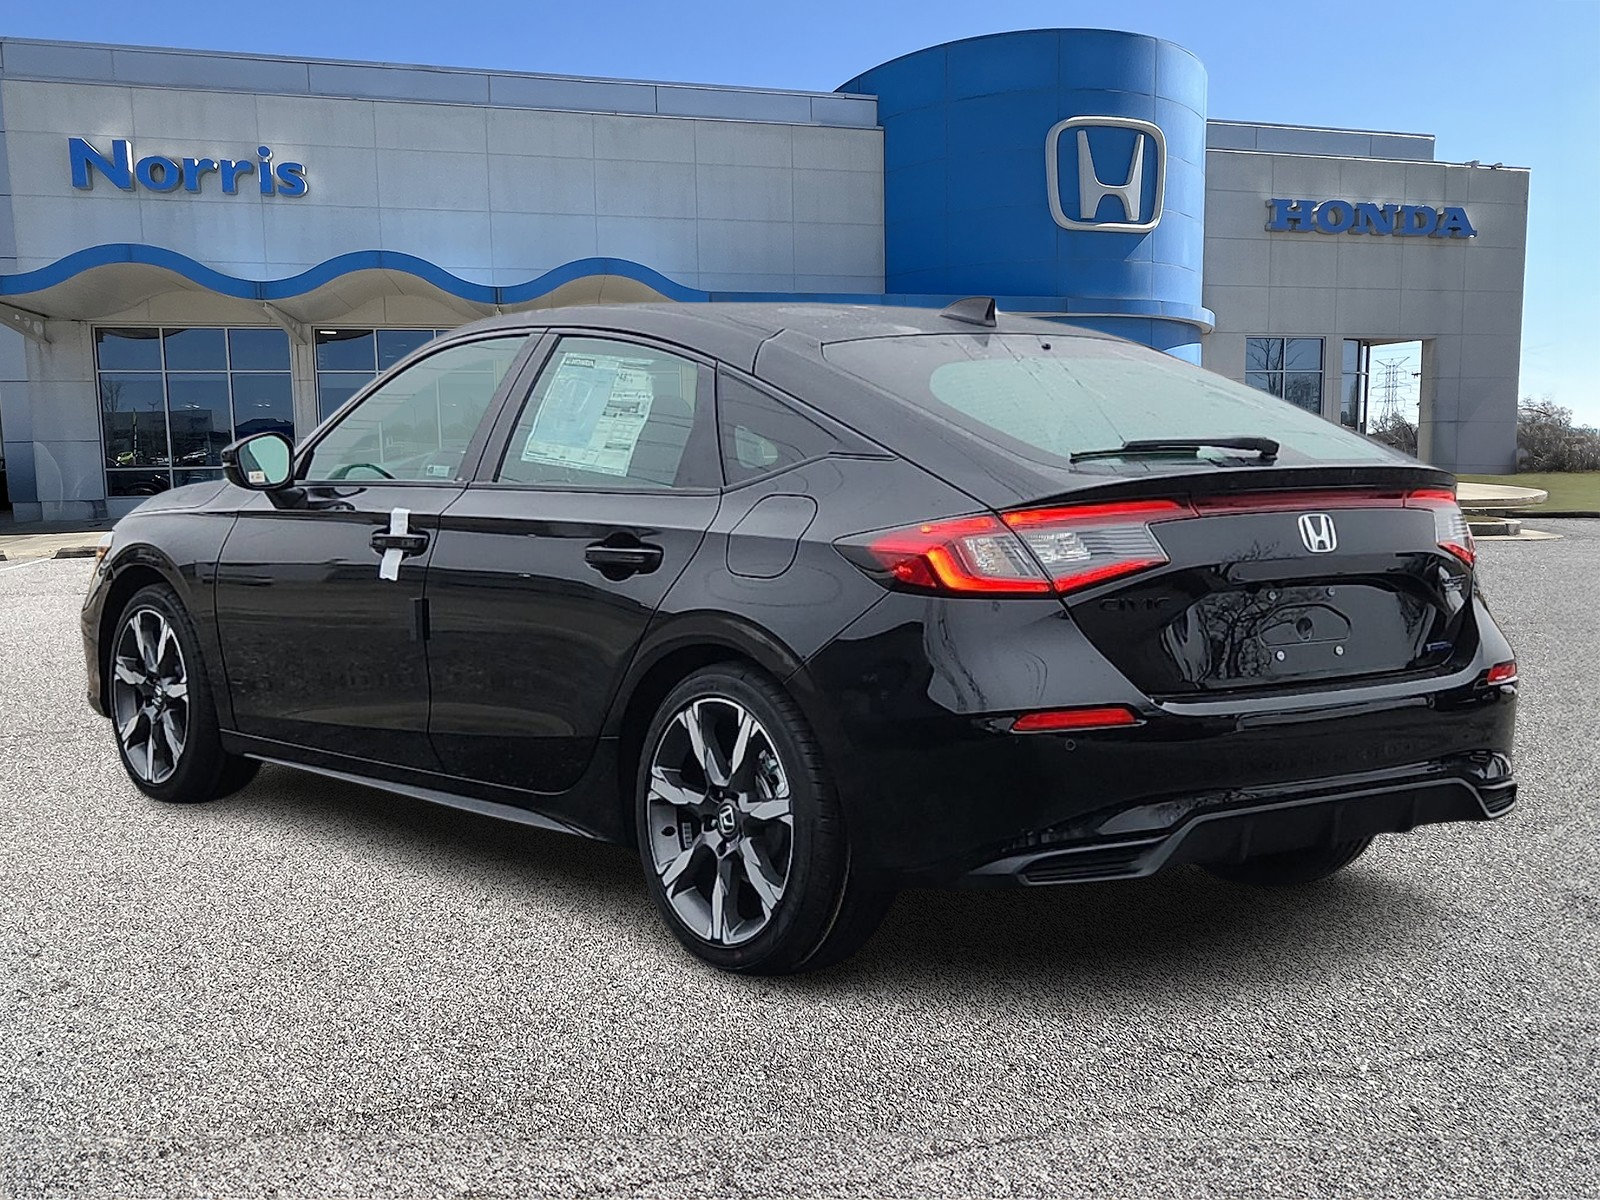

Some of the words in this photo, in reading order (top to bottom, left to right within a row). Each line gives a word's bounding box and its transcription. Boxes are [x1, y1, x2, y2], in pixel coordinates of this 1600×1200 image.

[68, 137, 309, 198] Norris
[1265, 198, 1478, 239] HONDA
[1099, 597, 1170, 612] CIVIC
